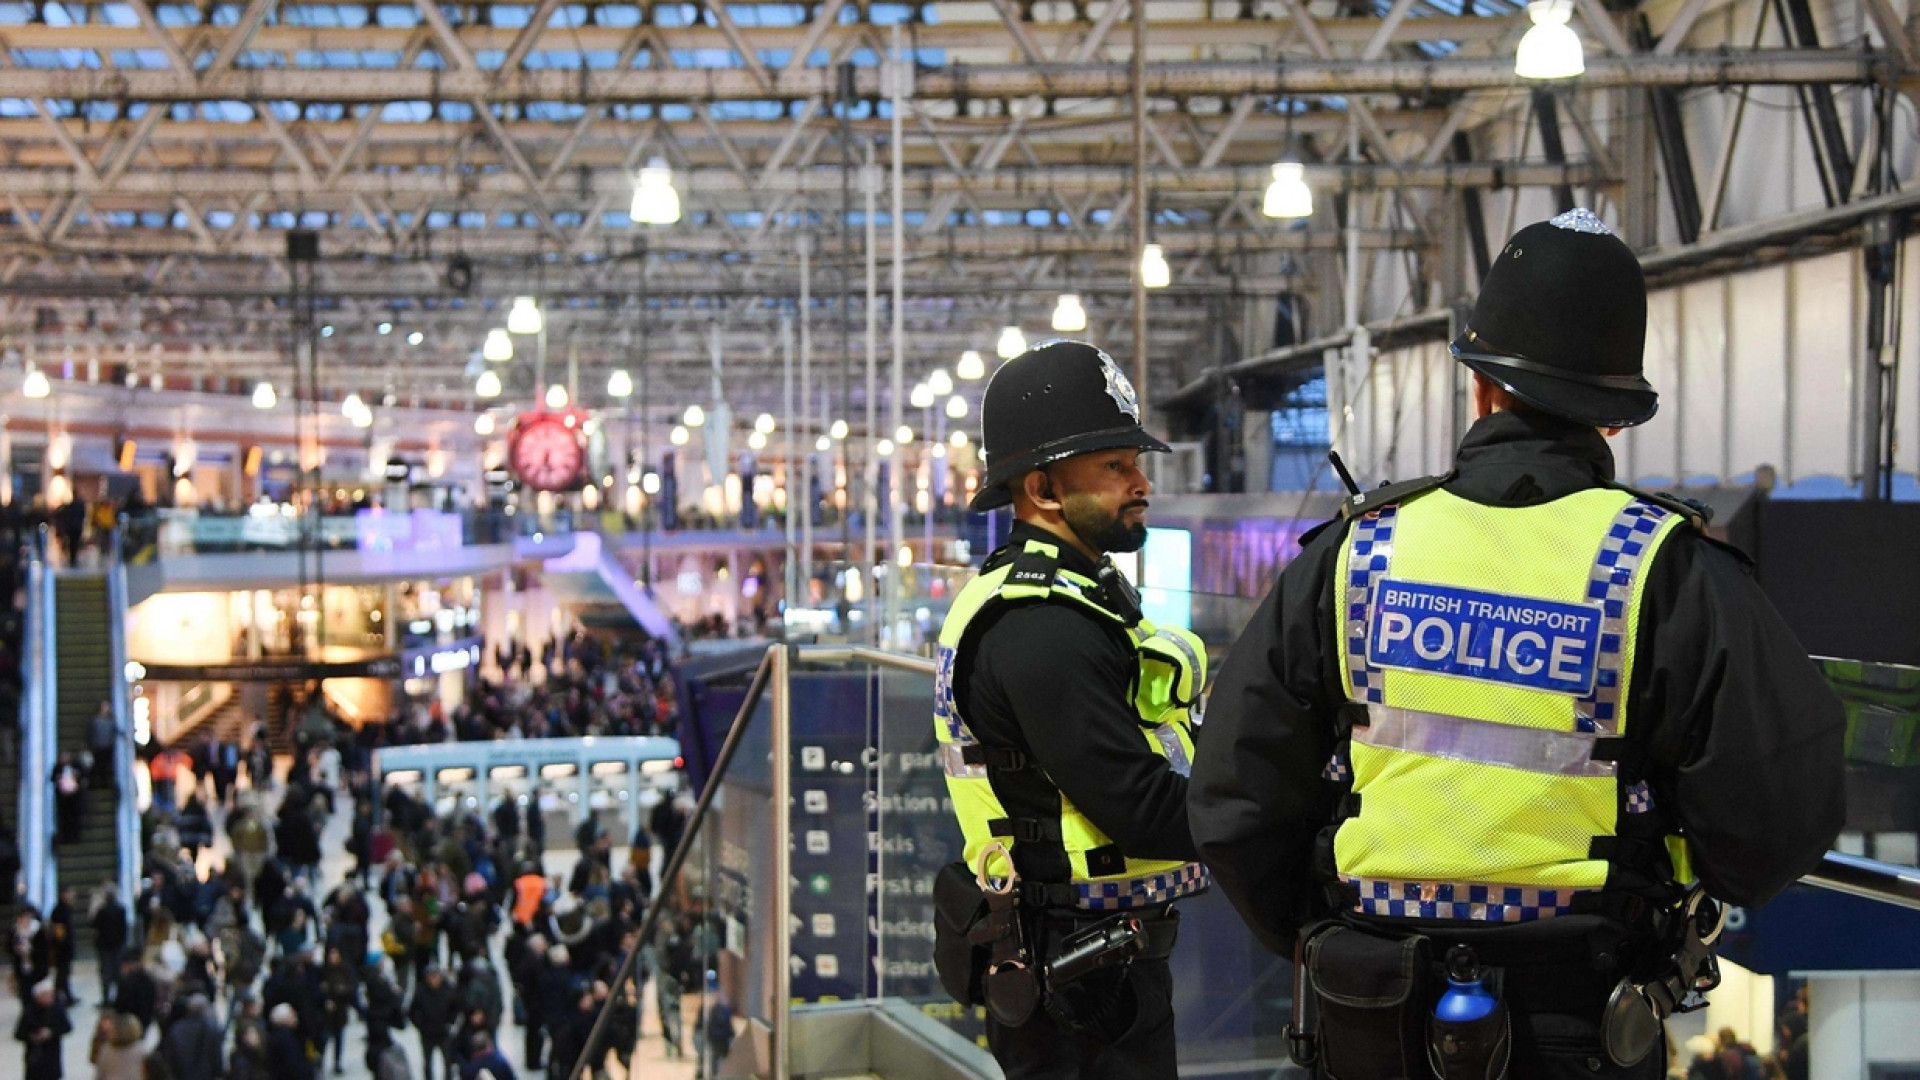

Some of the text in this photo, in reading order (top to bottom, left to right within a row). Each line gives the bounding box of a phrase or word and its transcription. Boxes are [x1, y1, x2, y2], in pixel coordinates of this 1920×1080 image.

[1384, 590, 1590, 632] BRITISH TRANSPORT
[1378, 612, 1587, 683] POLICE
